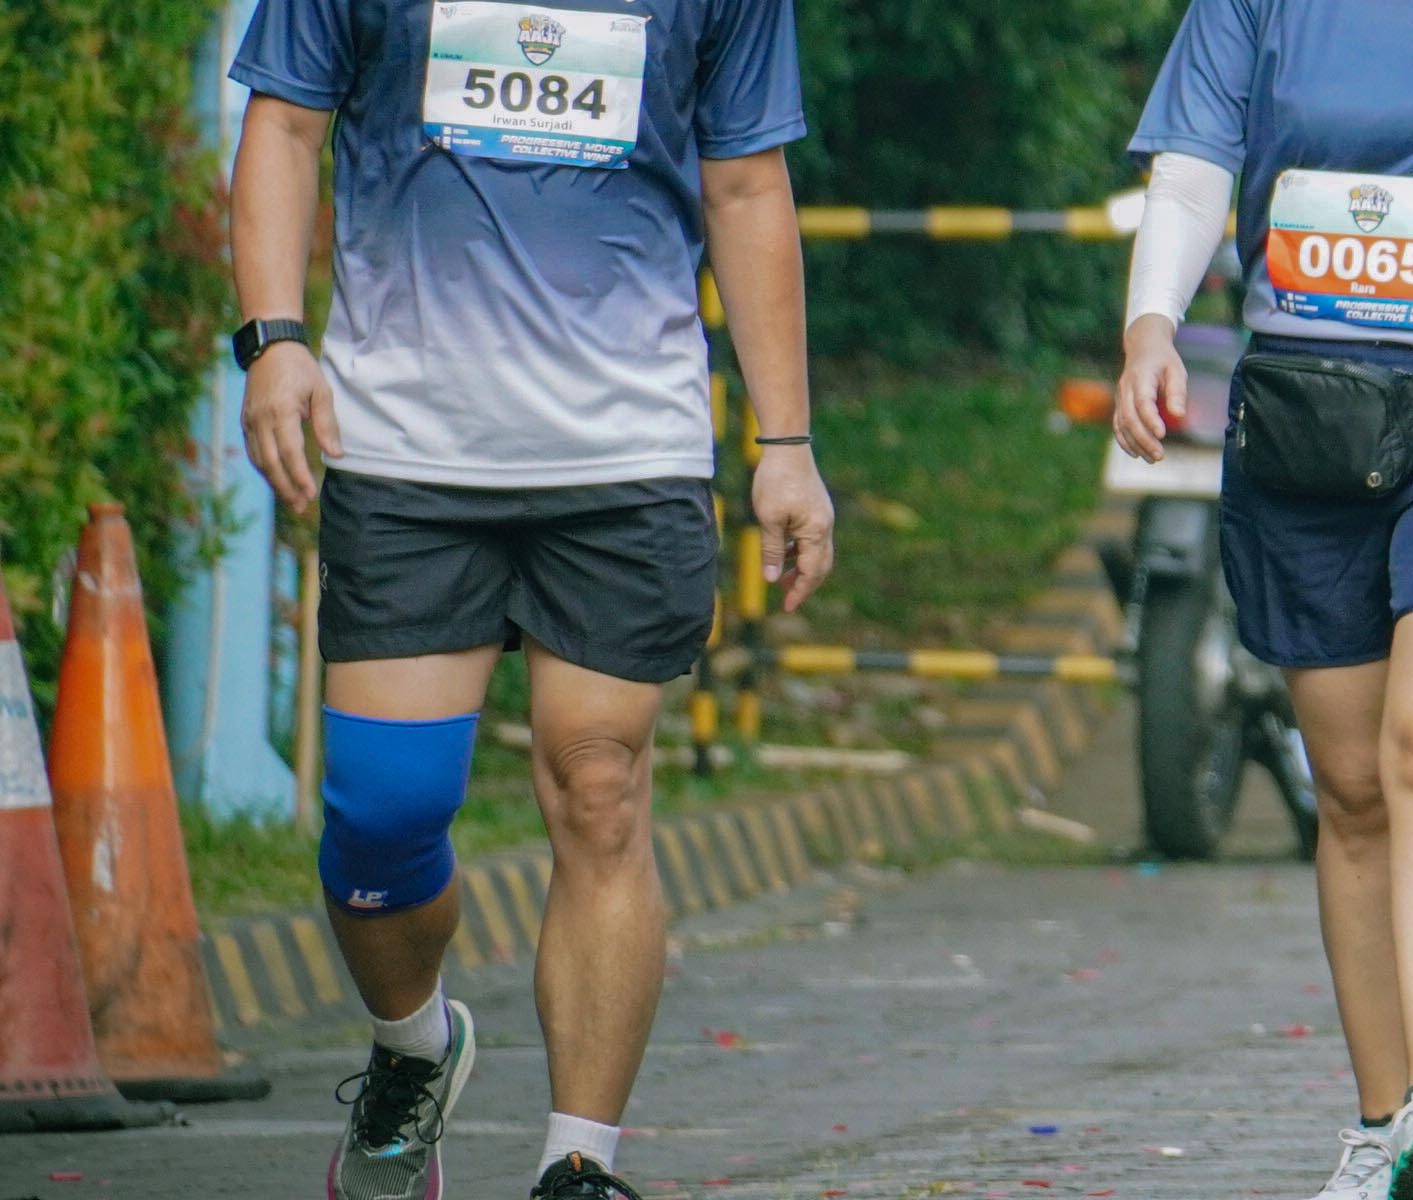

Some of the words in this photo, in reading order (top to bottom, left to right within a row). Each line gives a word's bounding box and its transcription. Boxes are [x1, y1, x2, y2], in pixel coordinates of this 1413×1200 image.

[462, 67, 606, 120] 5084
[493, 114, 526, 127] Irwan
[530, 117, 573, 132] Surjadi
[500, 134, 582, 150] PROGRESSIVE
[584, 143, 624, 154] MOVES
[512, 145, 578, 159] COLLECTIVE
[582, 152, 612, 163] WINS
[1351, 282, 1376, 295] Rara
[1335, 300, 1409, 314] PROGRESSIVE
[1346, 311, 1405, 323] COLLECTIVE
